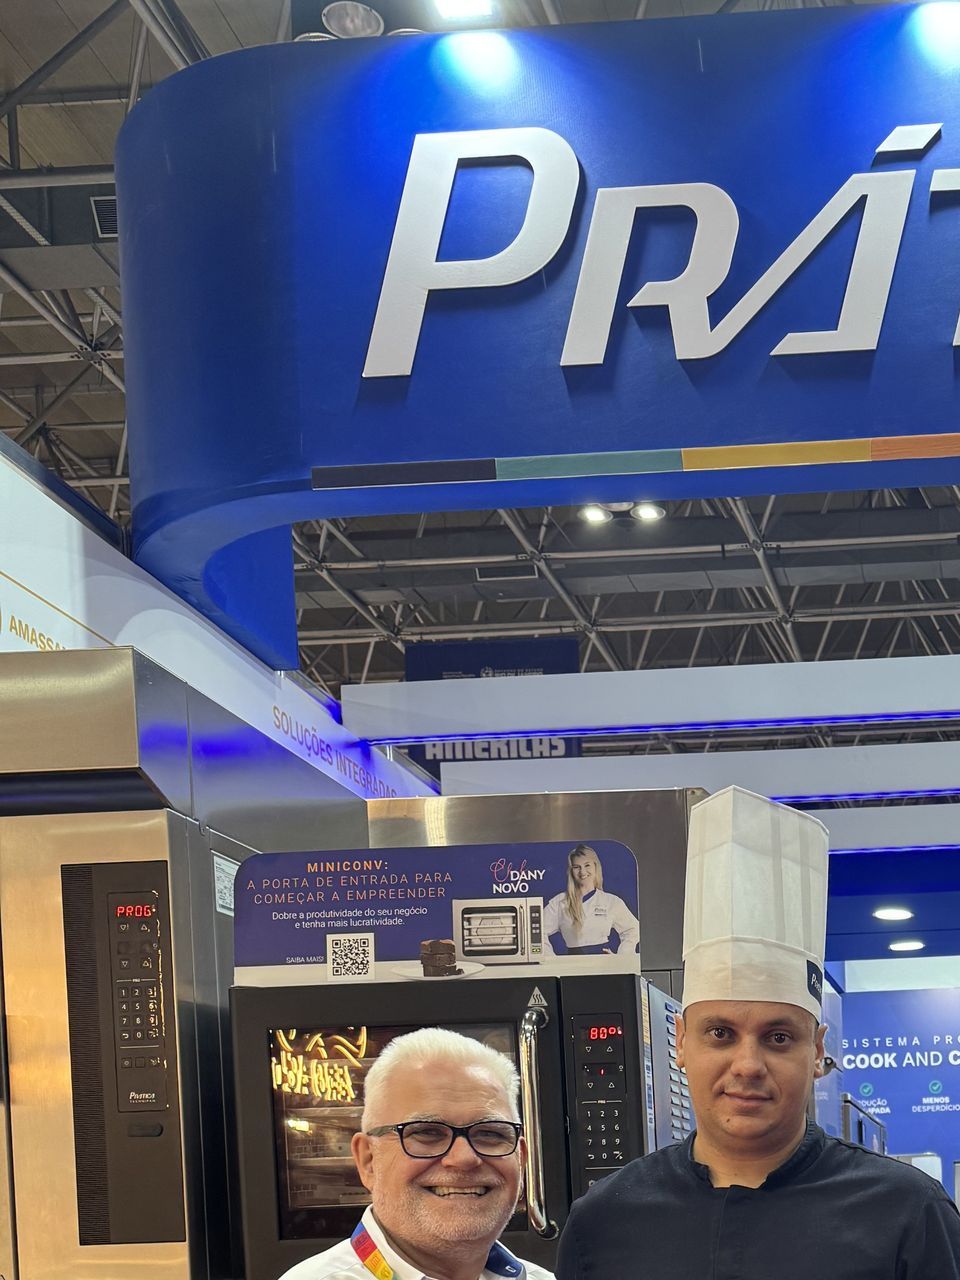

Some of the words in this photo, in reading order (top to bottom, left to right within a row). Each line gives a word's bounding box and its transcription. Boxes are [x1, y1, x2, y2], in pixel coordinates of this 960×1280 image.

[272, 705, 333, 766] SOLUÇÕES
[307, 860, 389, 873] MINICONV:
[247, 880, 255, 890] A
[262, 877, 309, 889] PORTA
[316, 876, 333, 888] DE
[341, 874, 408, 887] ENTRADA
[415, 872, 453, 883] PARA
[510, 869, 545, 882] DANY
[492, 880, 529, 894] NOVO
[254, 892, 325, 905] COMEÇAR
[332, 891, 340, 901] A
[347, 887, 446, 901] EMPREENDER
[272, 911, 297, 920] Dobre
[306, 909, 363, 920] produtividade
[365, 908, 376, 917] do
[394, 906, 428, 918] negócio
[302, 919, 326, 928] tenha
[328, 918, 348, 927] mais
[286, 956, 305, 964] SAIBA
[842, 1036, 920, 1048] SISTEMA
[843, 1053, 898, 1069] COOK
[902, 1051, 942, 1067] AND
[912, 1104, 960, 1113] DESPERDÍCIO
